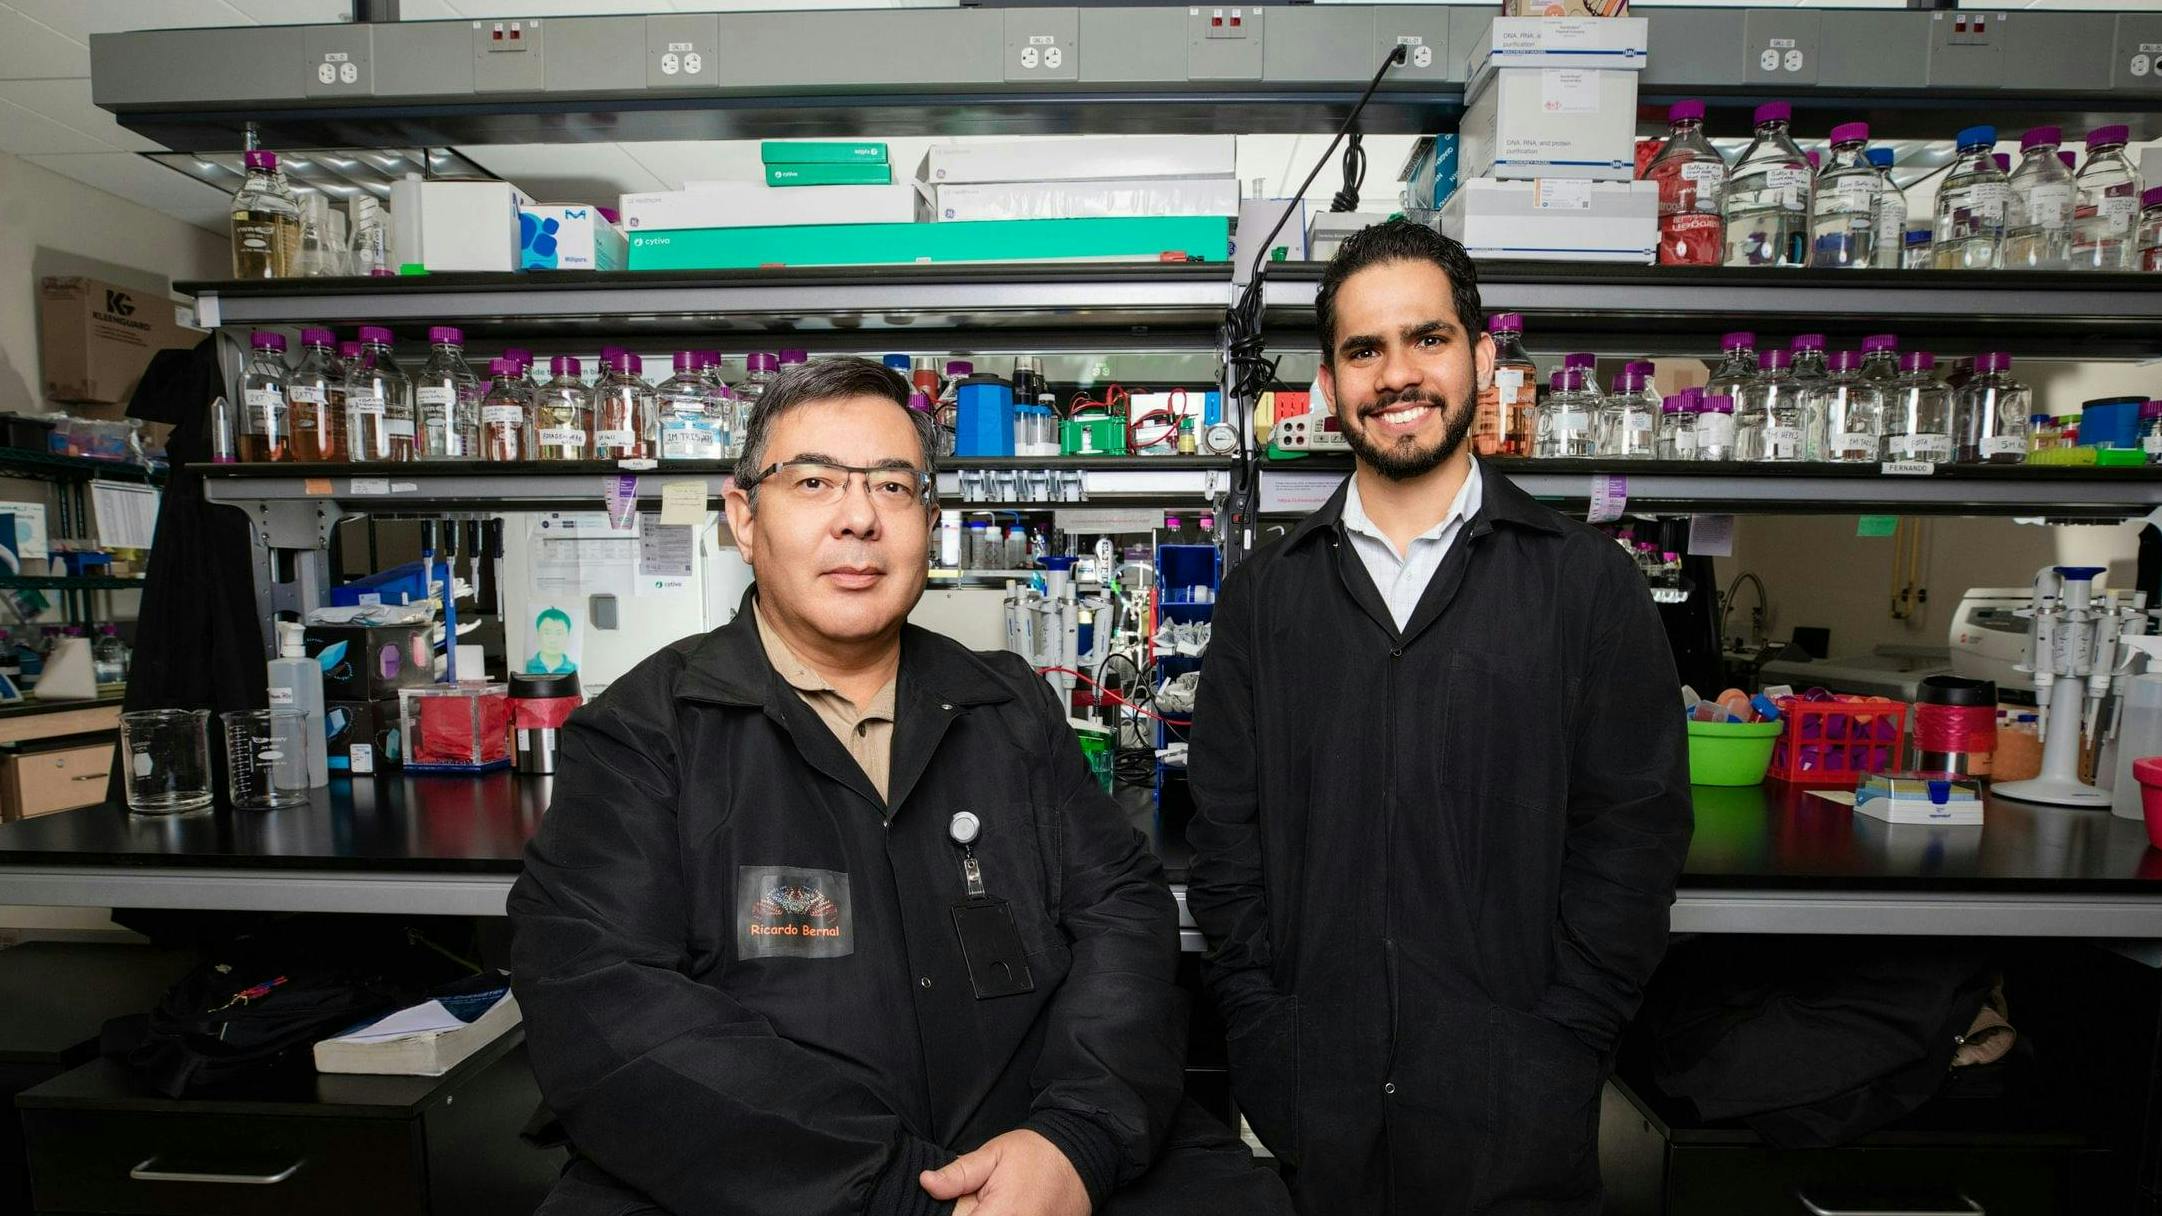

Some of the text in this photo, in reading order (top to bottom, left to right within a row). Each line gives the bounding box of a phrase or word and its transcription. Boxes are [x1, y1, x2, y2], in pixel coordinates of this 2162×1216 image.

[644, 237, 671, 247] cytiva
[92, 311, 152, 331] KLEENGUARD
[1889, 463, 1928, 473] FERNANDO
[751, 923, 840, 938] Ricardo Bernal
